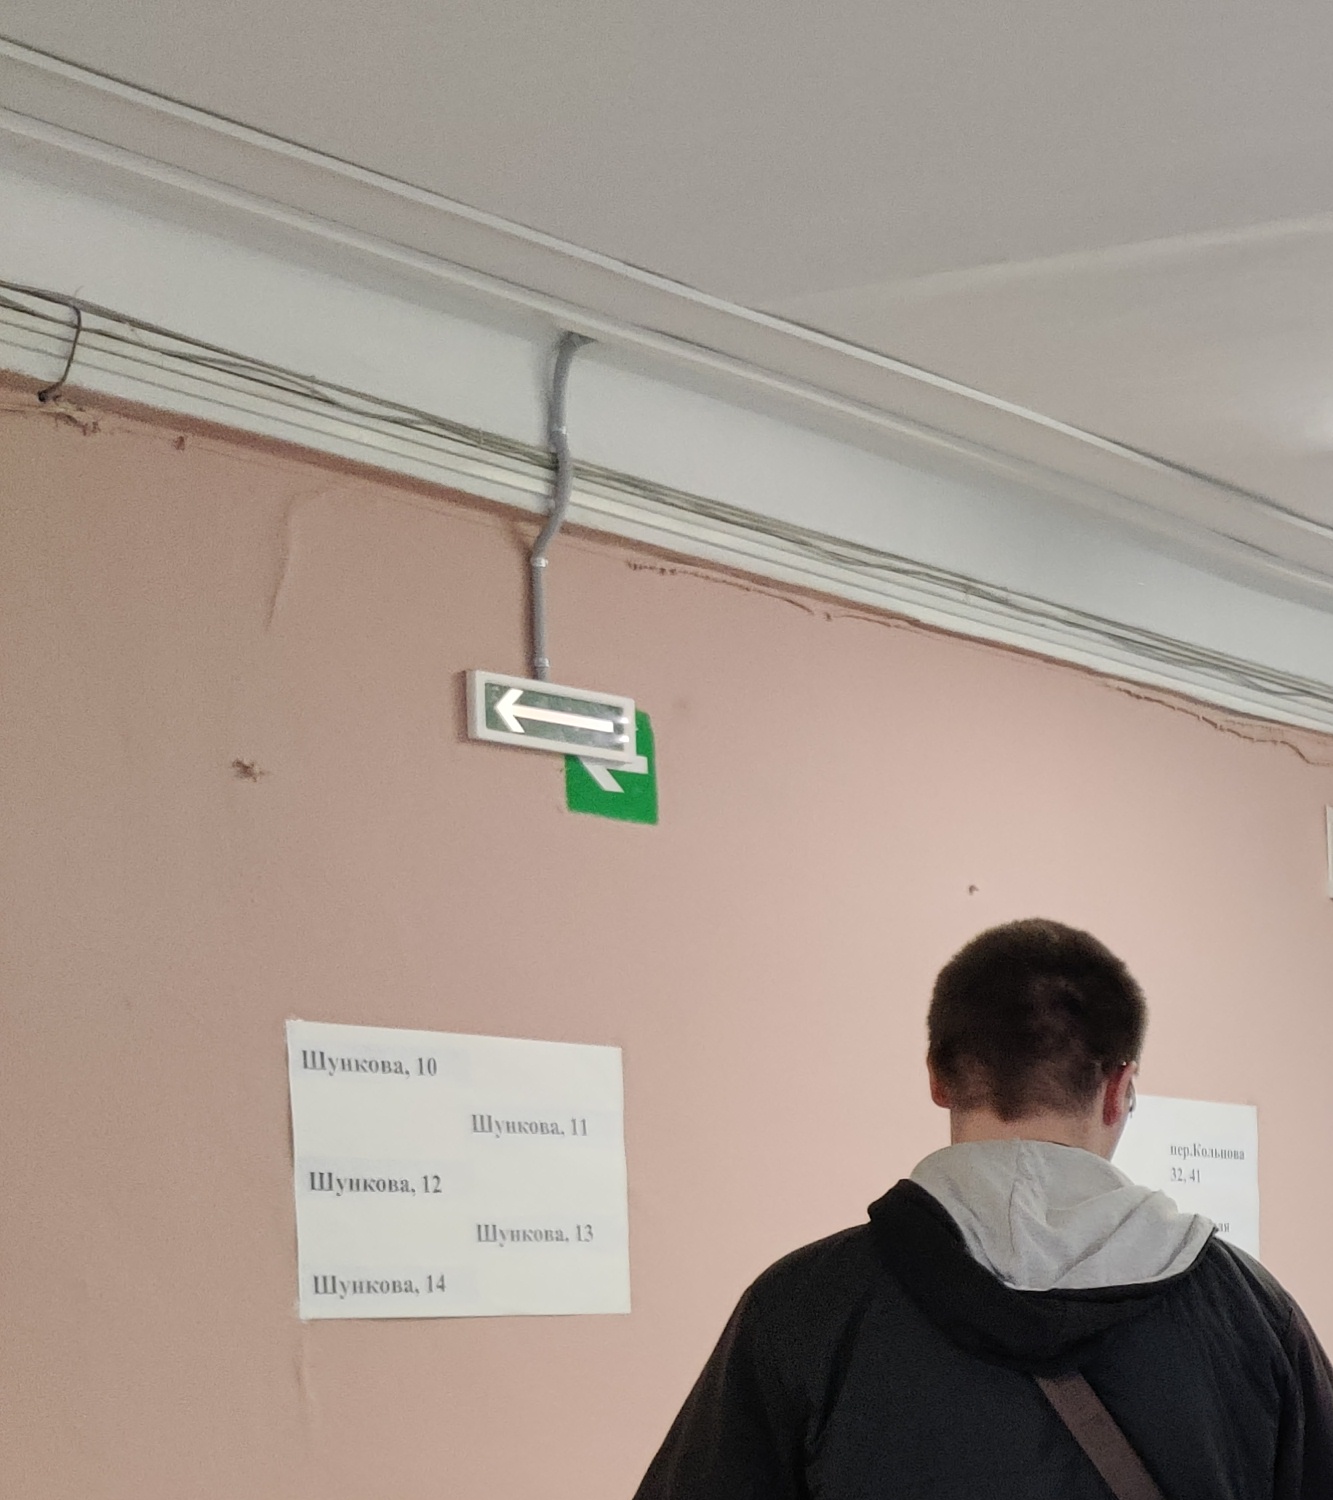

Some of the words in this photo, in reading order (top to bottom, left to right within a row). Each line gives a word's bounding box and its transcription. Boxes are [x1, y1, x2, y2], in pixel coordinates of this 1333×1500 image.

[302, 1049, 410, 1078] Шункова,
[417, 1056, 438, 1076] 10
[471, 1114, 565, 1138] Шункова,
[570, 1117, 588, 1136] 11
[309, 1171, 416, 1197] Шункова,
[422, 1175, 442, 1193] 12
[1171, 1167, 1187, 1184] 32,
[1189, 1168, 1201, 1183] 41
[476, 1224, 569, 1247] Шункова,
[575, 1224, 594, 1243] 13
[312, 1275, 420, 1299] Шункова,
[426, 1274, 446, 1293] 14
